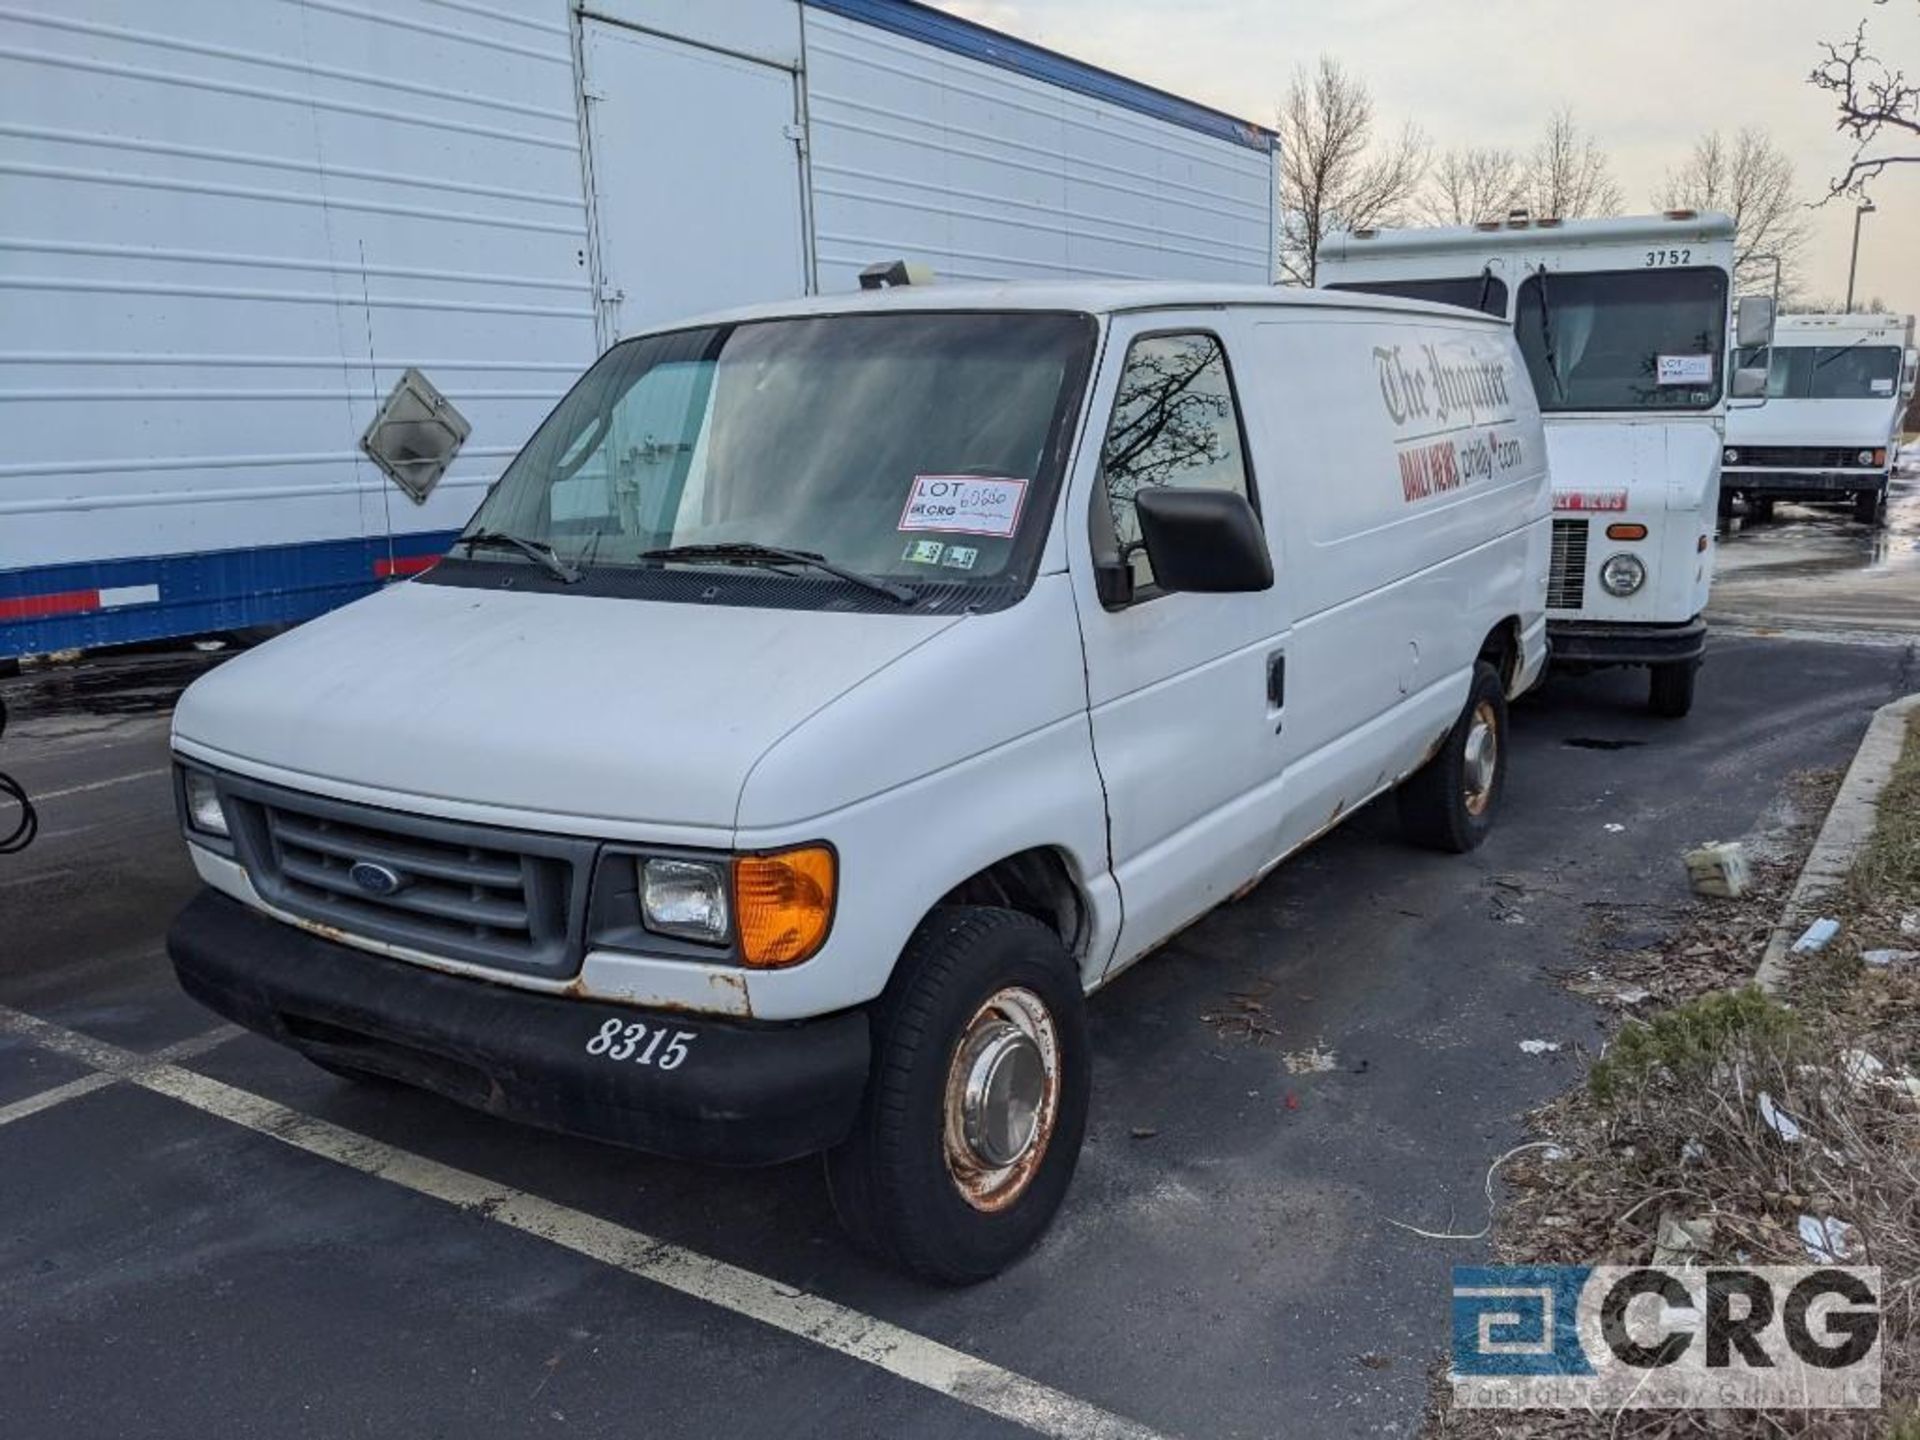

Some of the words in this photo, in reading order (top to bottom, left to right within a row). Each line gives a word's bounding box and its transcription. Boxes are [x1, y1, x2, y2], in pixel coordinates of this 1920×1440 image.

[1646, 250, 1691, 267] 3752
[1373, 344, 1430, 427] The
[1421, 343, 1510, 425] Inquirer
[917, 482, 965, 498] LOT
[1397, 448, 1432, 502] DAILY
[585, 1018, 698, 1070] 8315
